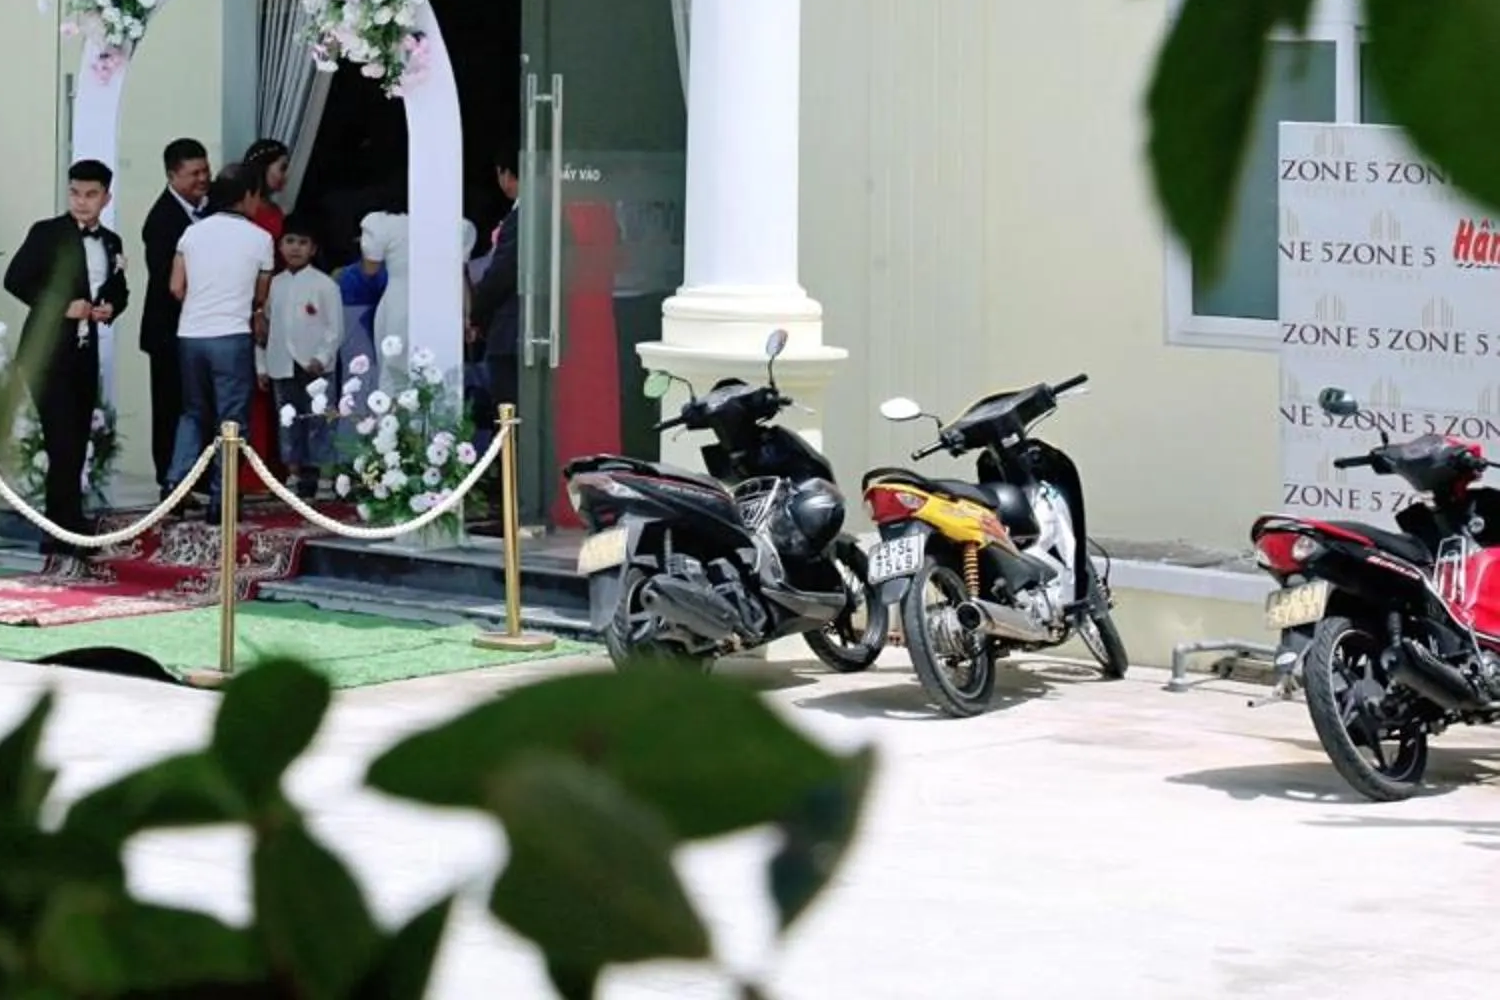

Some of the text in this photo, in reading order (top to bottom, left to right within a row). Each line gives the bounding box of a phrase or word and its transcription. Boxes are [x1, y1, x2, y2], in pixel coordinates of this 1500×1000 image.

[1281, 158, 1358, 183] ZONE
[1386, 162, 1446, 185] ZON
[1281, 323, 1359, 348] ZONE
[1388, 328, 1467, 355] ZONE
[1283, 483, 1362, 511] ZONE
